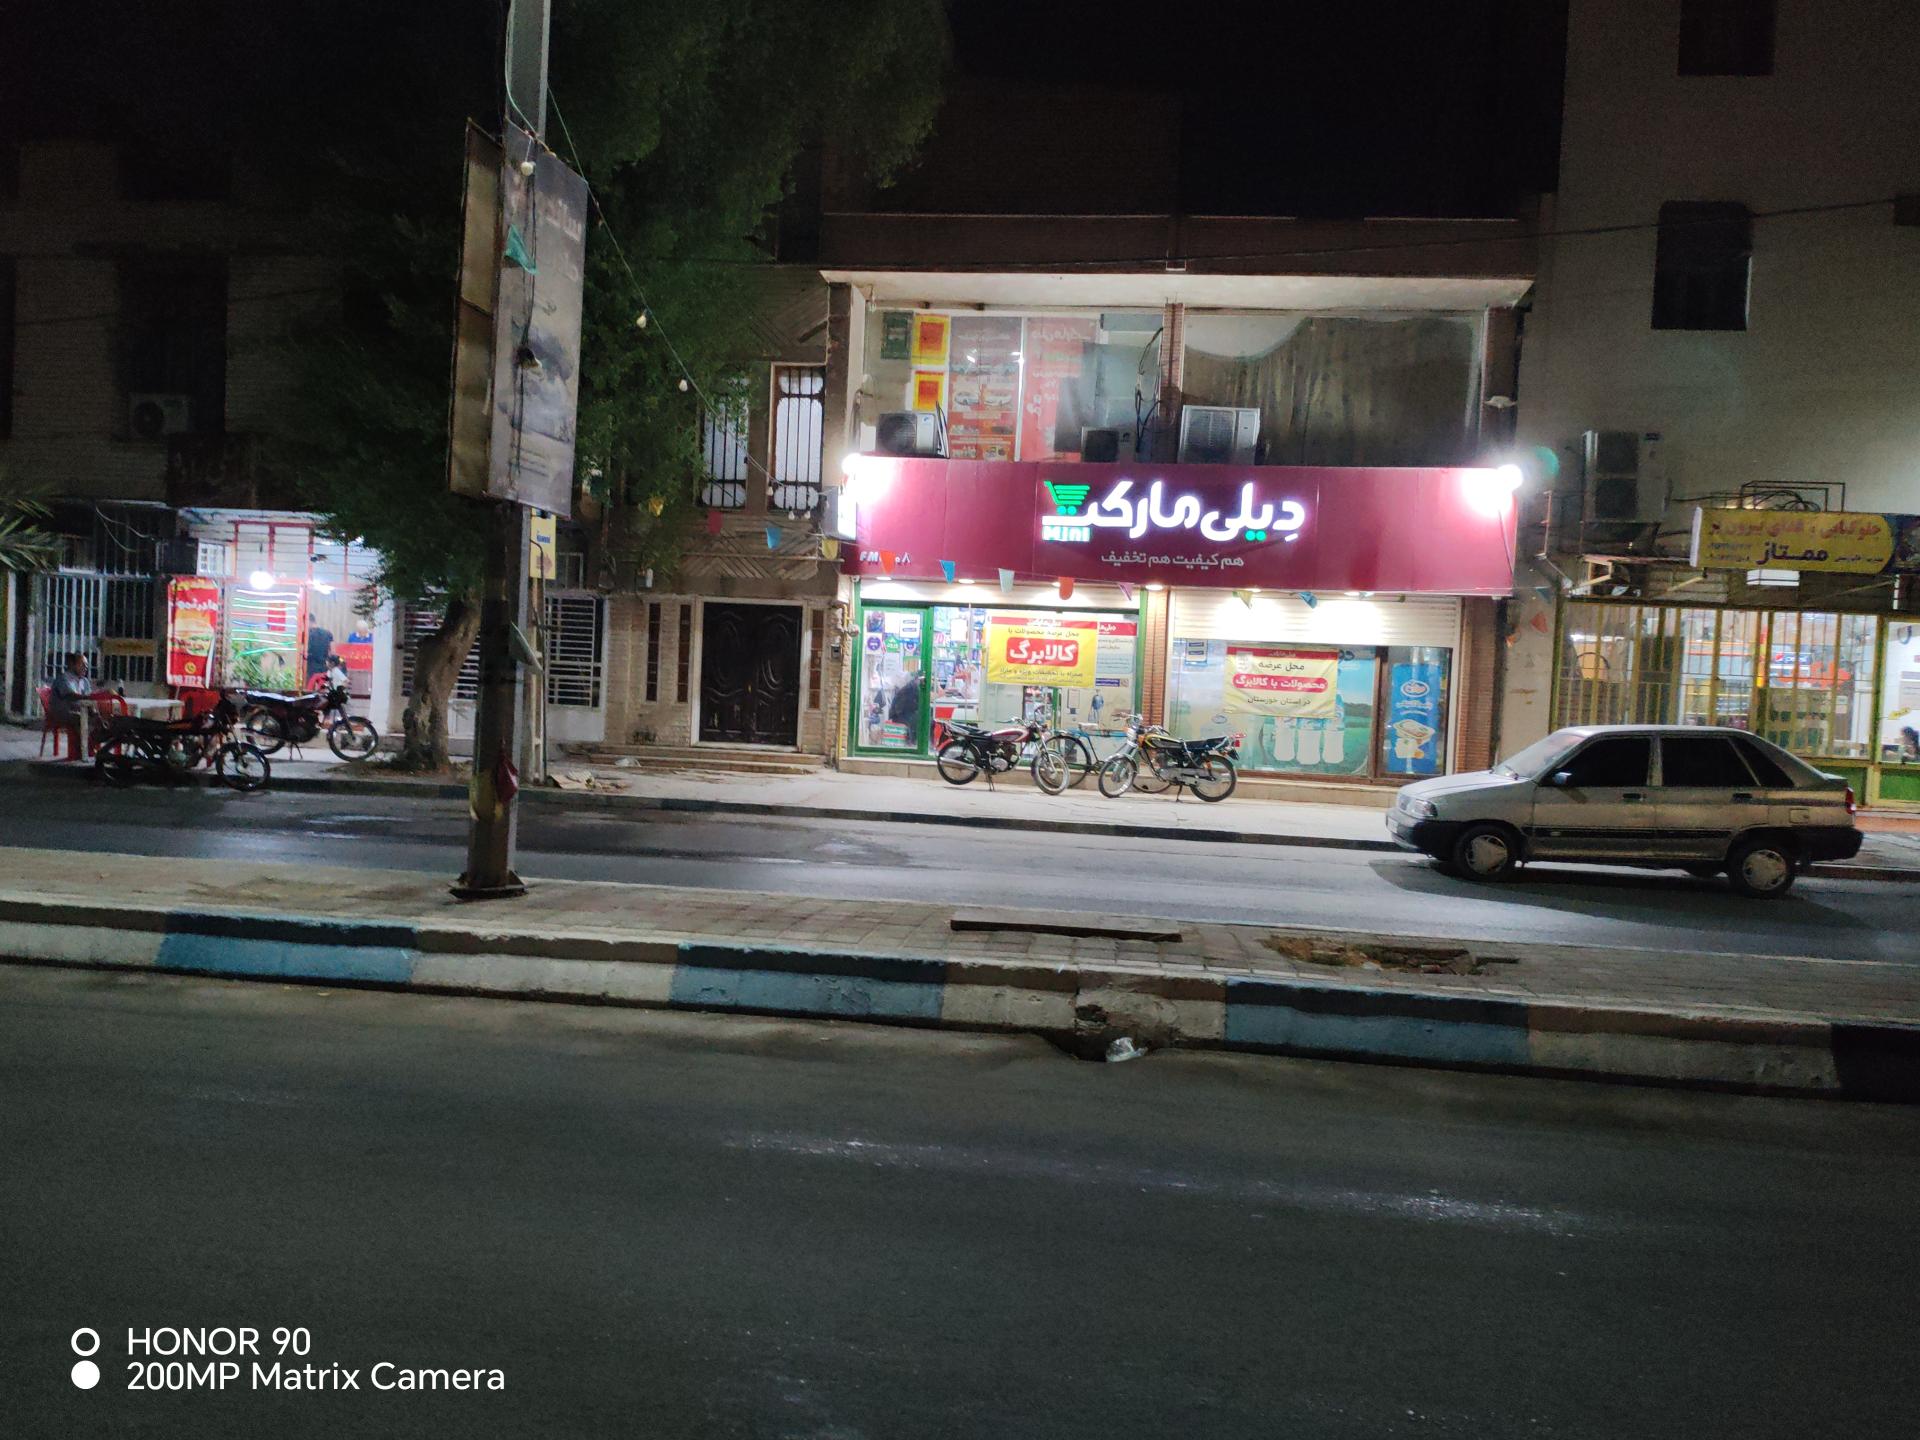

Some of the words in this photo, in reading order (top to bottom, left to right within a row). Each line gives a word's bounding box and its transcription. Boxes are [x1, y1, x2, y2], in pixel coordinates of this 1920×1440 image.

[1042, 481, 1201, 539] مارکت
[1101, 551, 1147, 566] تخفیف
[1756, 541, 1829, 565] ممتاز
[1149, 553, 1170, 567] هم
[1173, 553, 1218, 568] کیفیت
[1221, 554, 1244, 569] هم
[1009, 640, 1077, 665] کالابرگ
[1258, 661, 1282, 670] عرضه
[1285, 662, 1304, 671] محل
[1235, 675, 1268, 687] کالابرگ
[1271, 678, 1278, 689] با
[1281, 678, 1325, 690] محصولات
[1247, 696, 1278, 705] خوزستان
[1280, 697, 1302, 706] استان
